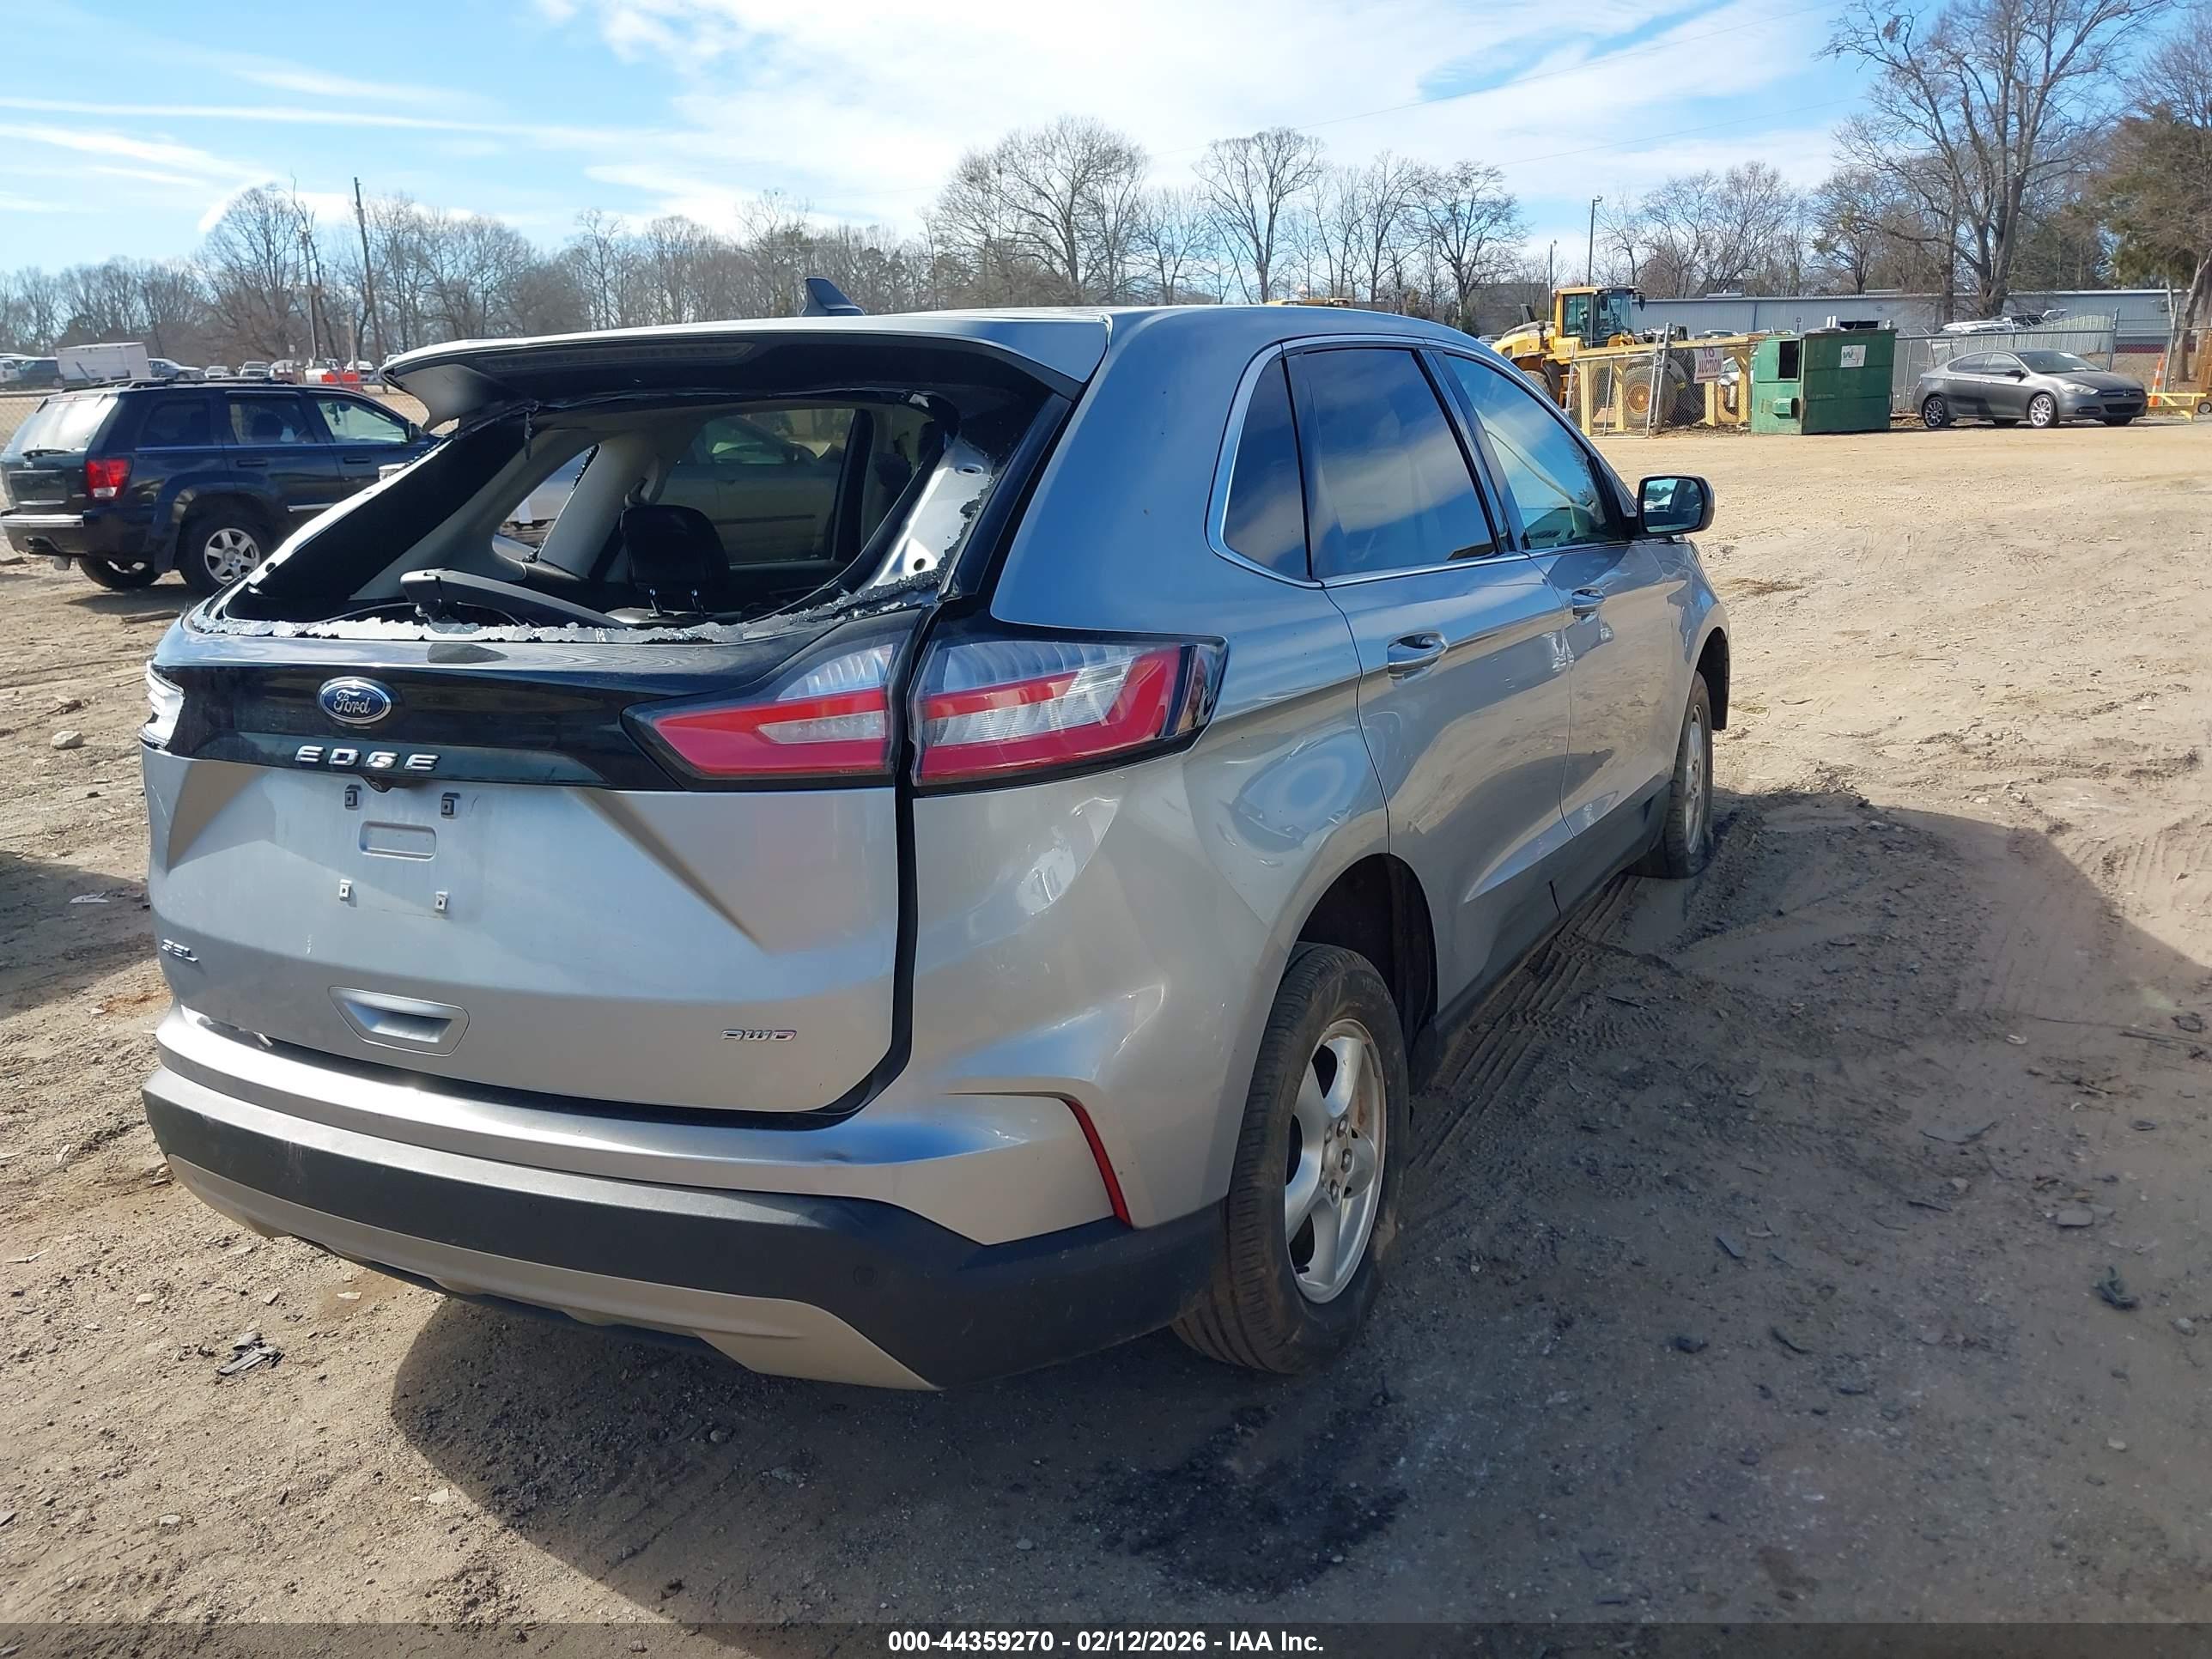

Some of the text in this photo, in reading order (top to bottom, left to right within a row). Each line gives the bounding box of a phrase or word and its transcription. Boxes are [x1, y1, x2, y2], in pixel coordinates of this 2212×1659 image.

[1698, 358, 1722, 374] AUCTION
[333, 689, 371, 714] Ford
[295, 745, 440, 771] EDGE
[721, 1029, 797, 1041] AWD
